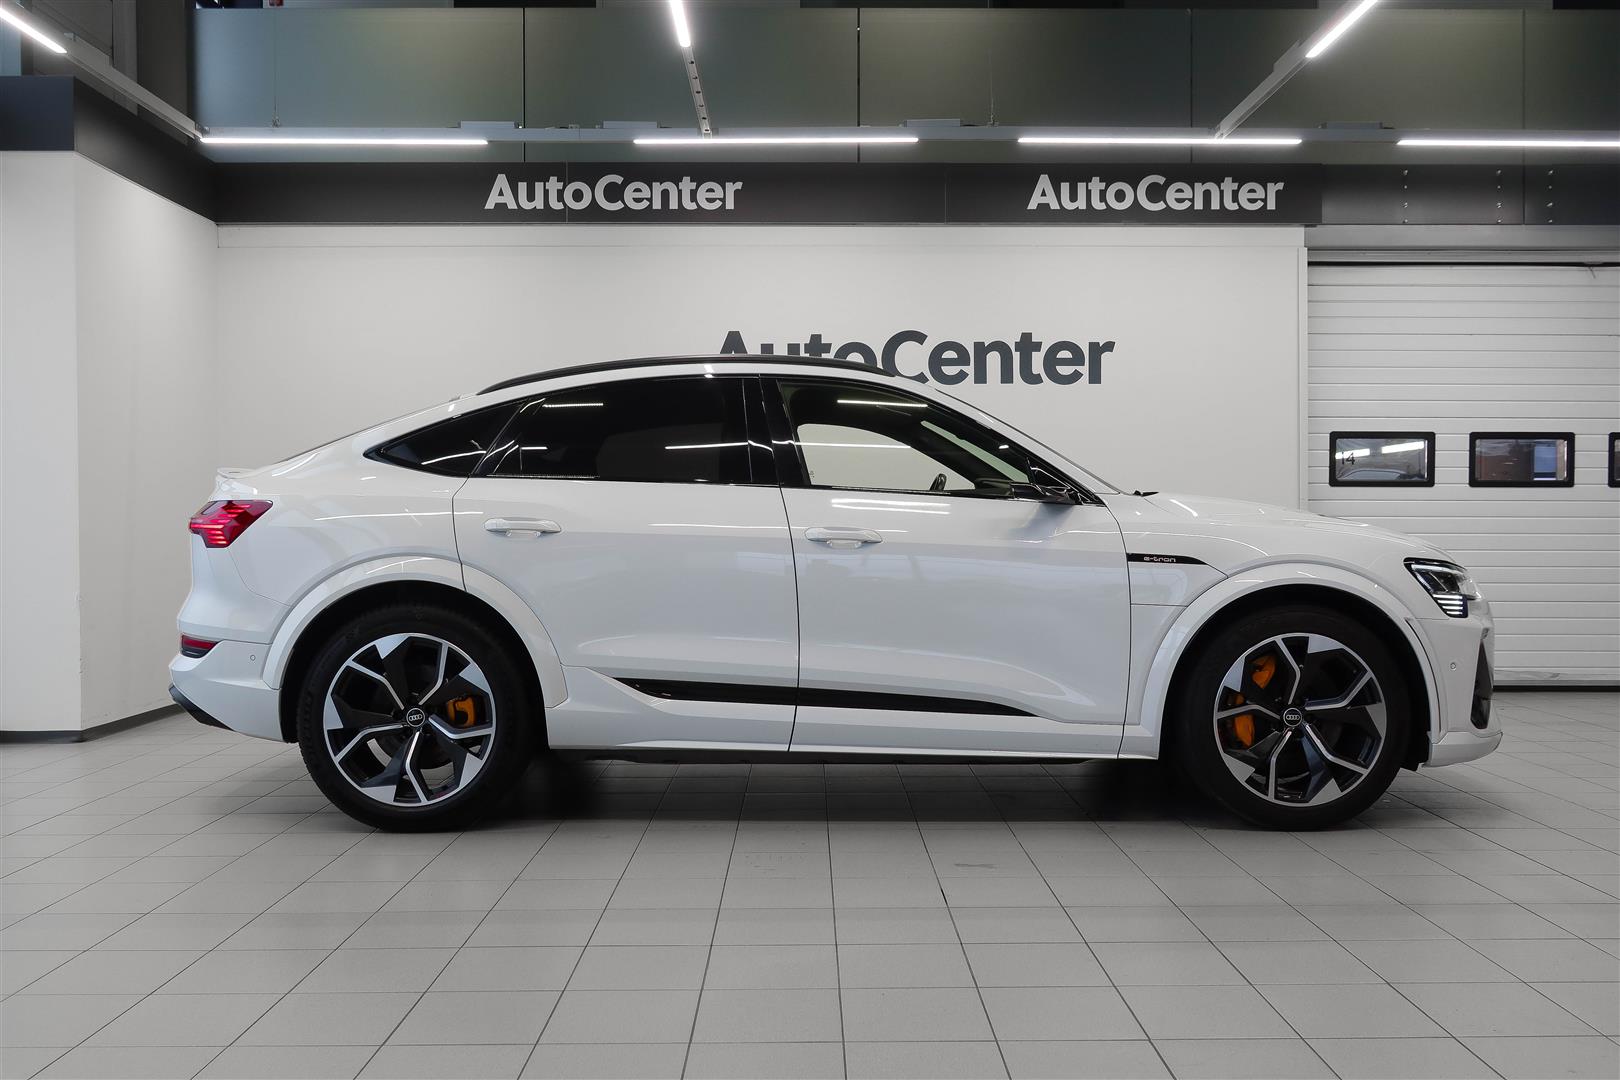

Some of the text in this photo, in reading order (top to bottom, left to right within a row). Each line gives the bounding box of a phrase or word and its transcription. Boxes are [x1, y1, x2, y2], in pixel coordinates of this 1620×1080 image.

[484, 174, 743, 211] AutoCenter
[1027, 174, 1285, 211] AutoCenter
[720, 330, 1116, 385] Center
